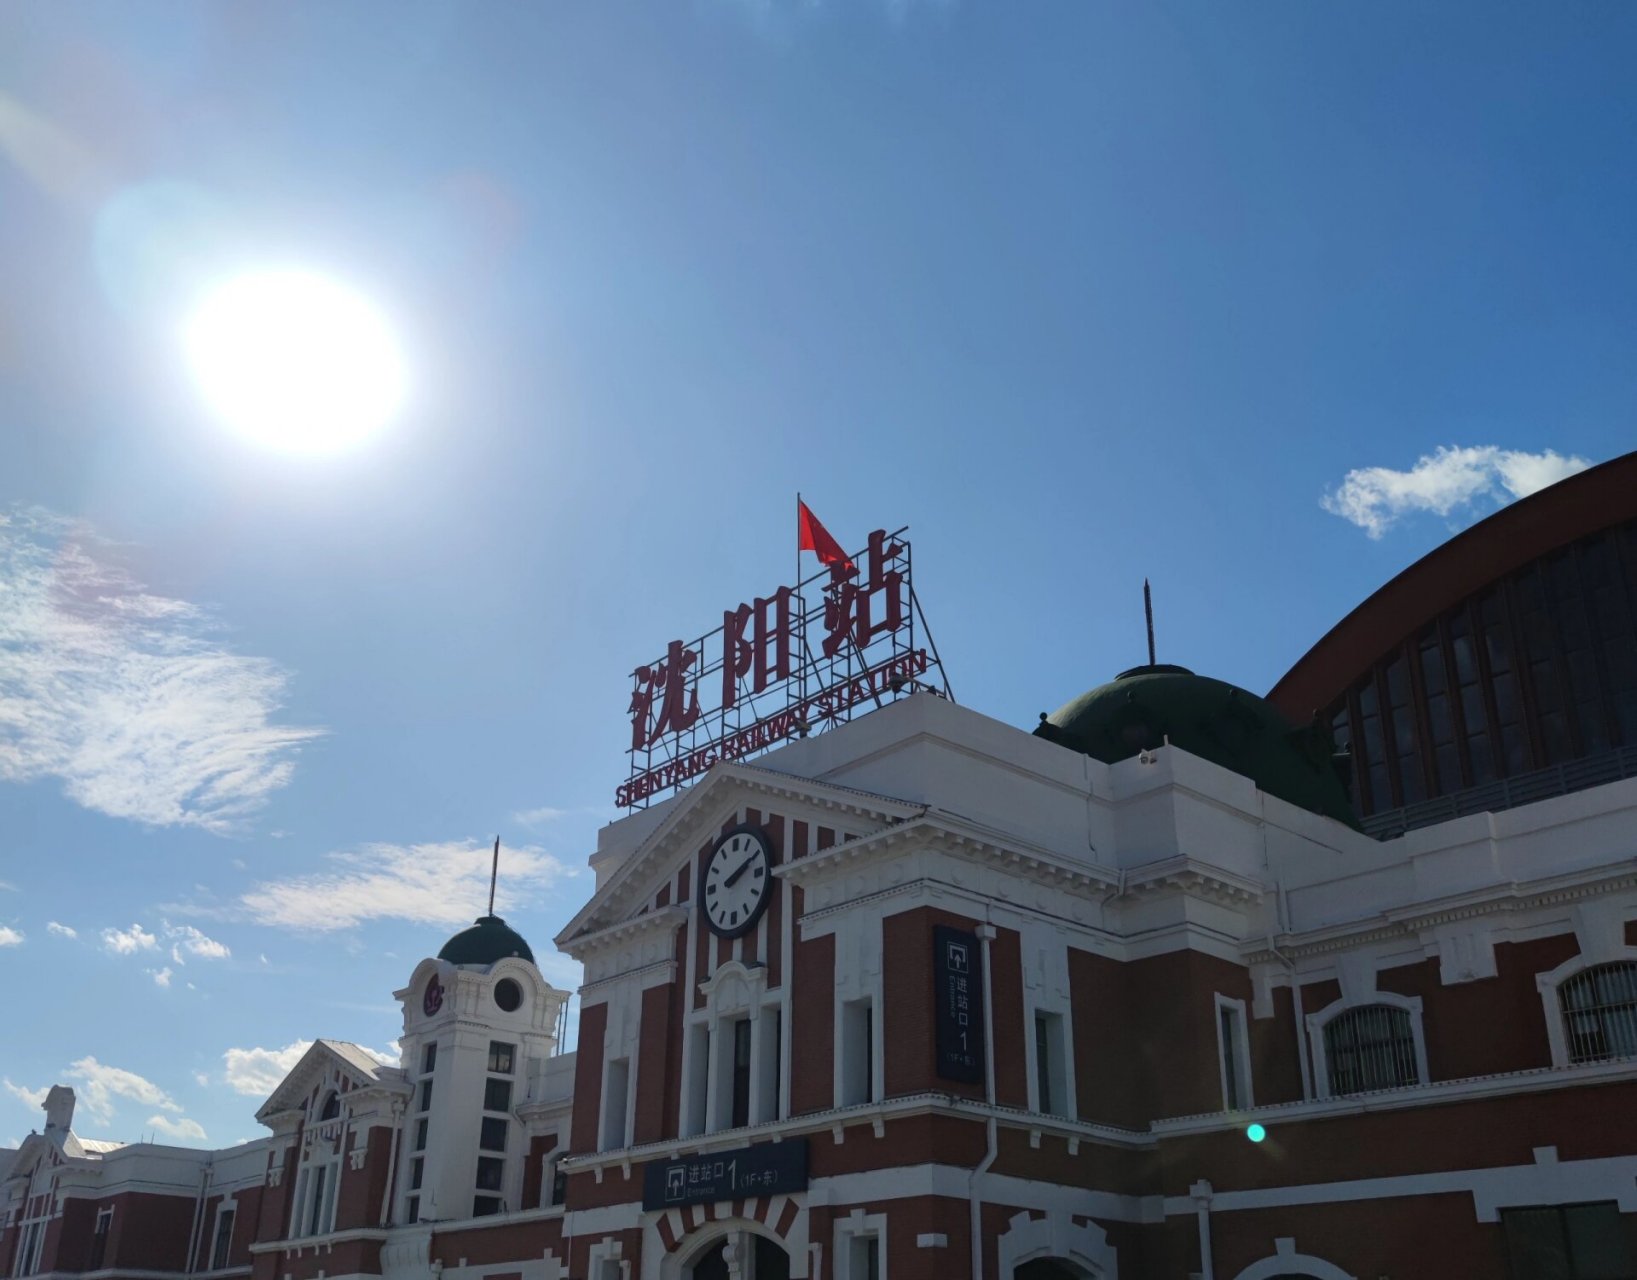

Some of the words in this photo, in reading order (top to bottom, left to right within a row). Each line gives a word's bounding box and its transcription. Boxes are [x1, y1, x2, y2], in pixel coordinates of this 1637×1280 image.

[615, 746, 717, 807] SHENYANG
[721, 702, 811, 760] RAILWAY
[818, 648, 927, 719] STATION
[627, 529, 903, 750] 沈阳站
